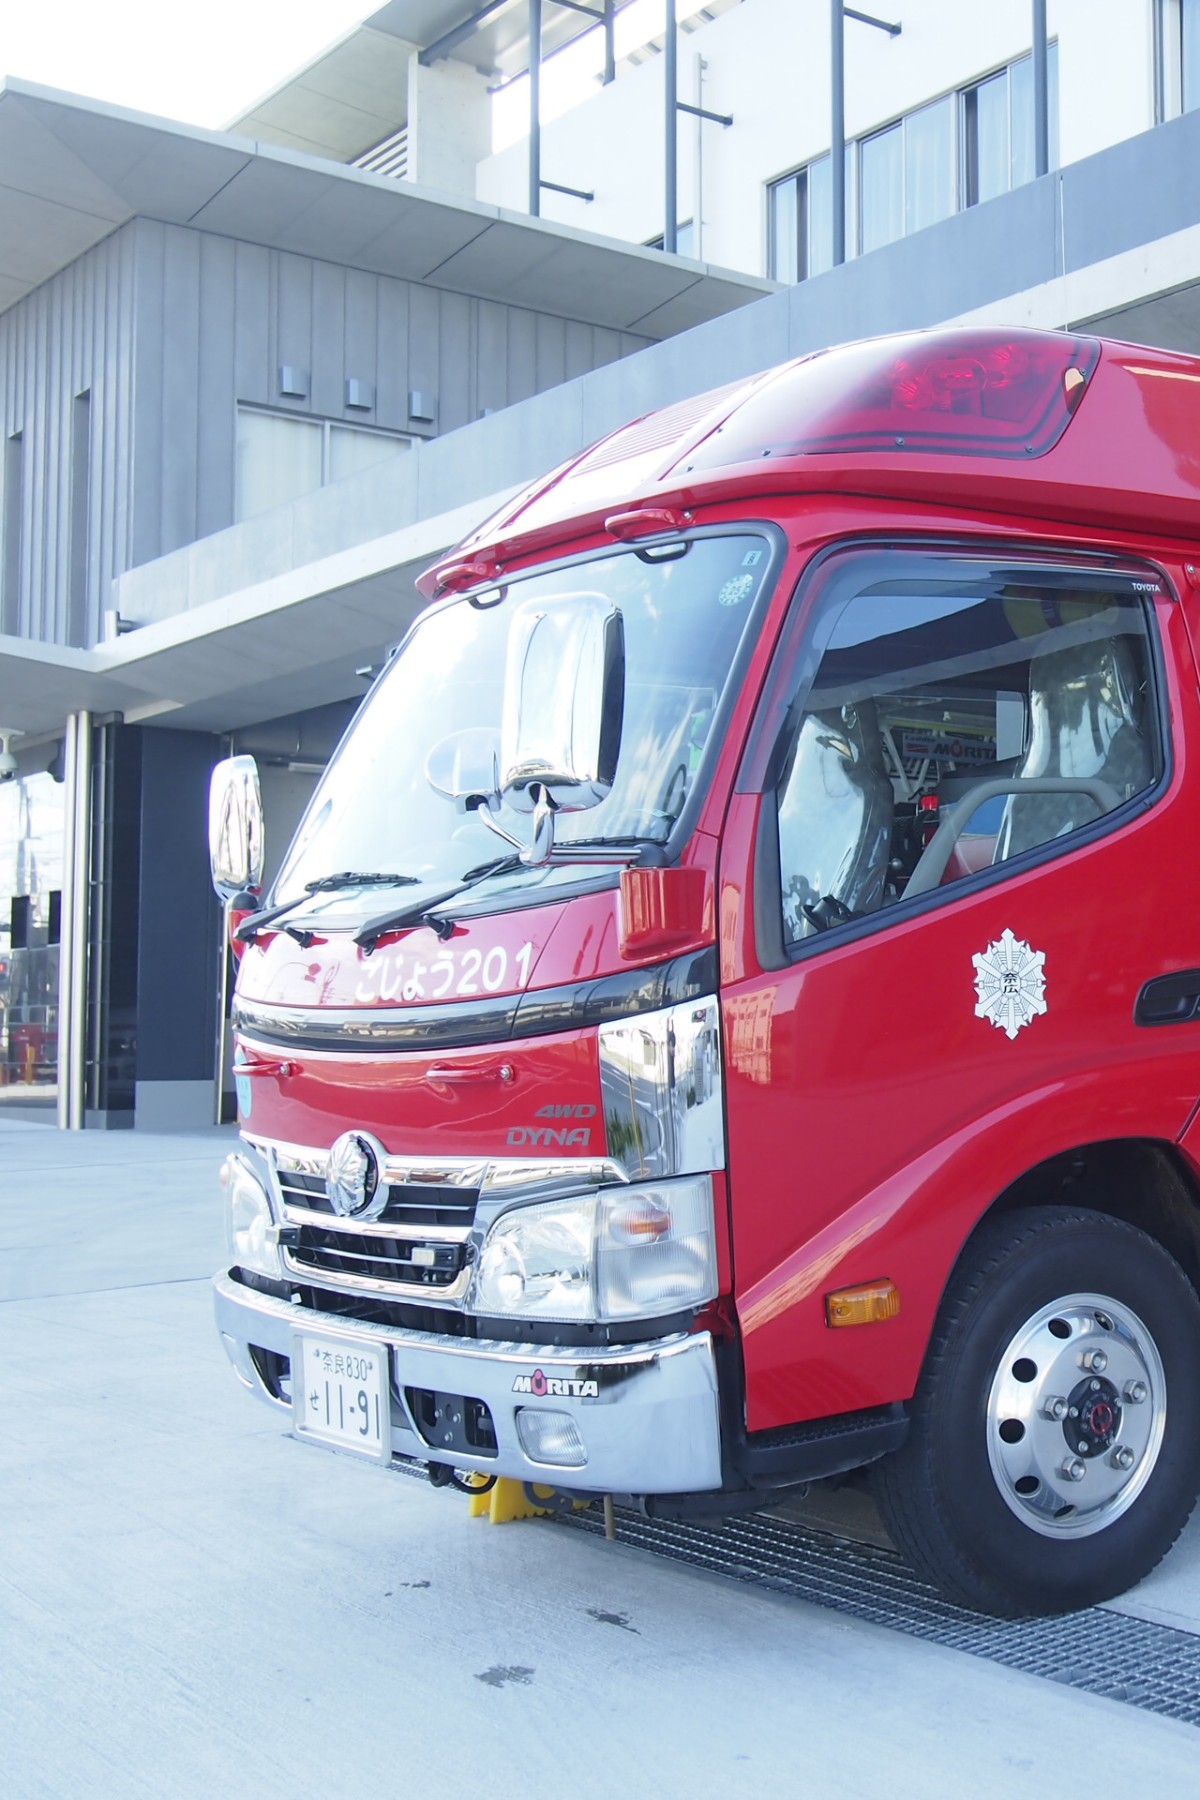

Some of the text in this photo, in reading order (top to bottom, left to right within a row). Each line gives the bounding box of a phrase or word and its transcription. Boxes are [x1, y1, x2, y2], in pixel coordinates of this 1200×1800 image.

[1132, 582, 1161, 592] TOYOTA
[535, 1104, 596, 1118] 4WD
[506, 1126, 591, 1147] DYNA
[512, 1368, 599, 1398] MORITA
